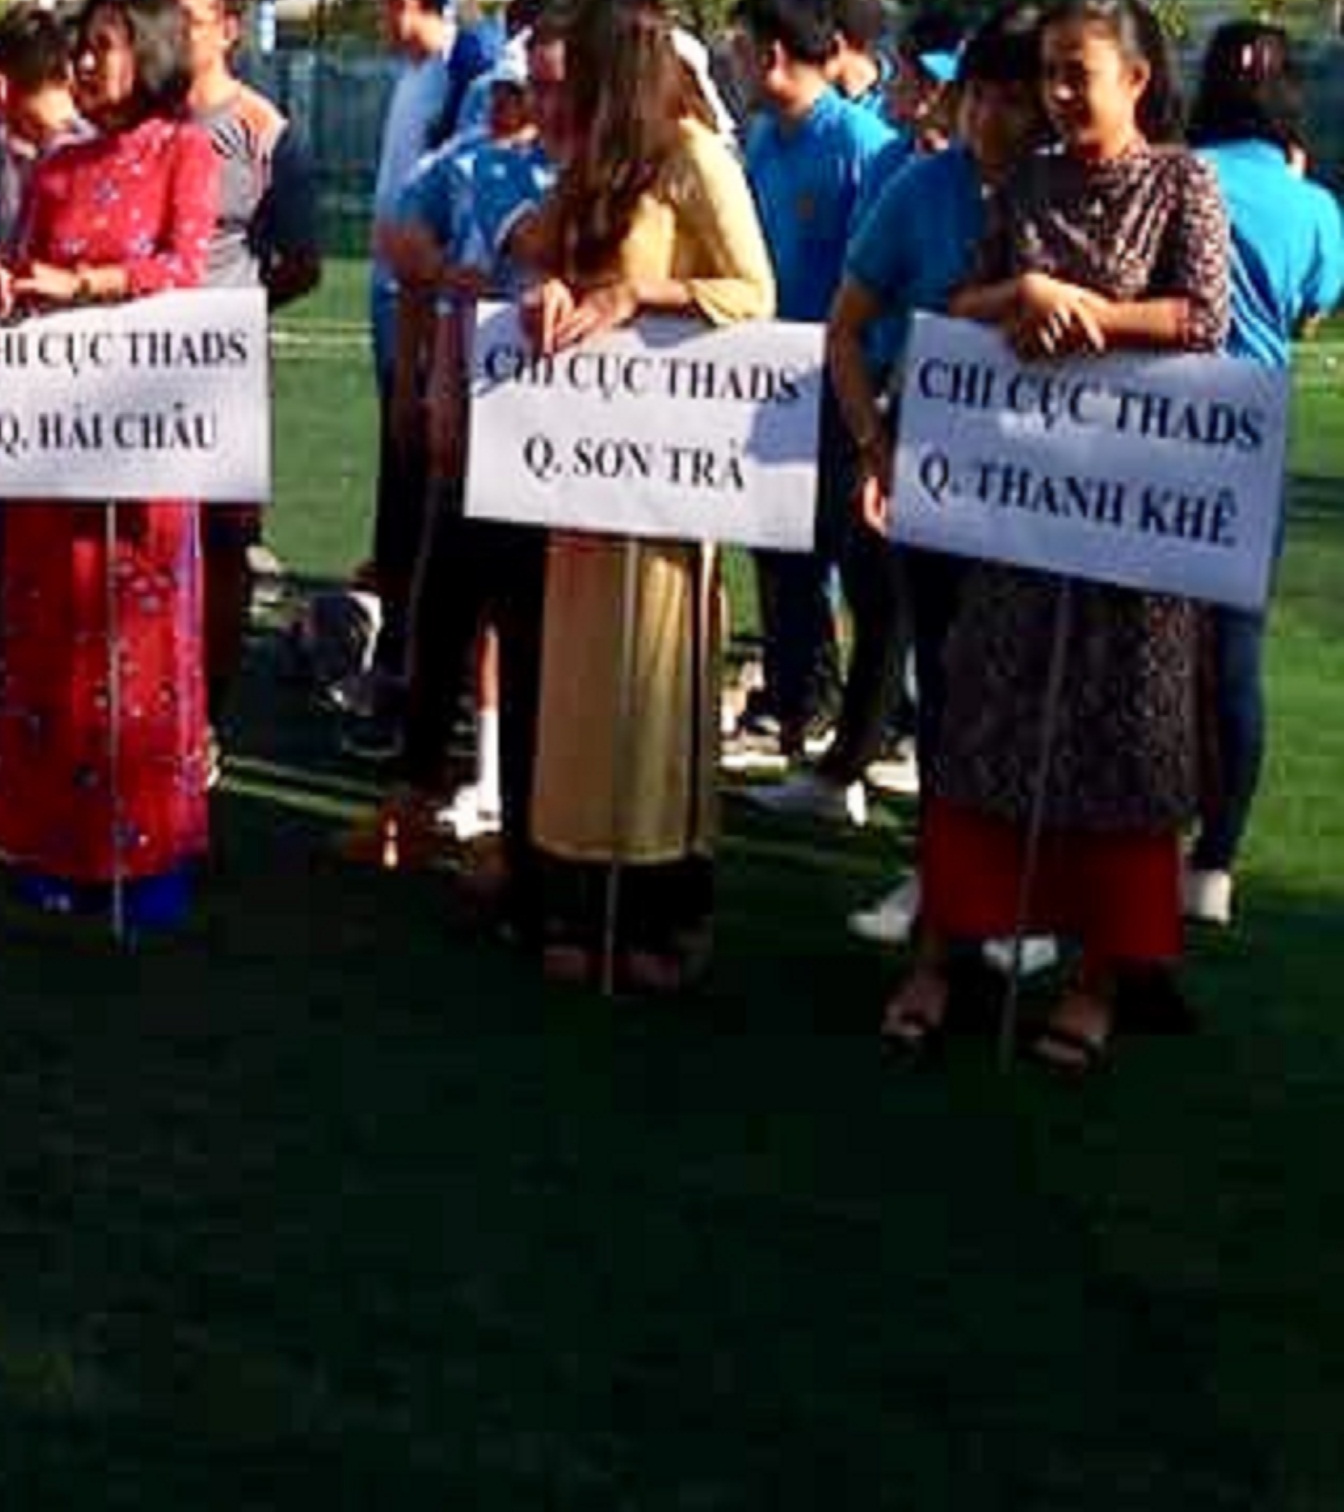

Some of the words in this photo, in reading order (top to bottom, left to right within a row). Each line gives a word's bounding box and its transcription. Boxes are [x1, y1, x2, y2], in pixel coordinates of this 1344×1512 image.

[37, 331, 112, 377] CỤC
[123, 329, 248, 368] THADS
[485, 345, 555, 385] CHI
[567, 356, 654, 401] CỤC
[662, 359, 801, 405] THADS
[918, 358, 996, 410] CHI
[1006, 373, 1099, 431] CỤC
[1113, 389, 1266, 451] THADS
[524, 433, 563, 481] Q.
[919, 452, 959, 500] Q.
[970, 460, 1127, 528] THANH
[1139, 486, 1237, 548] KHÊ
